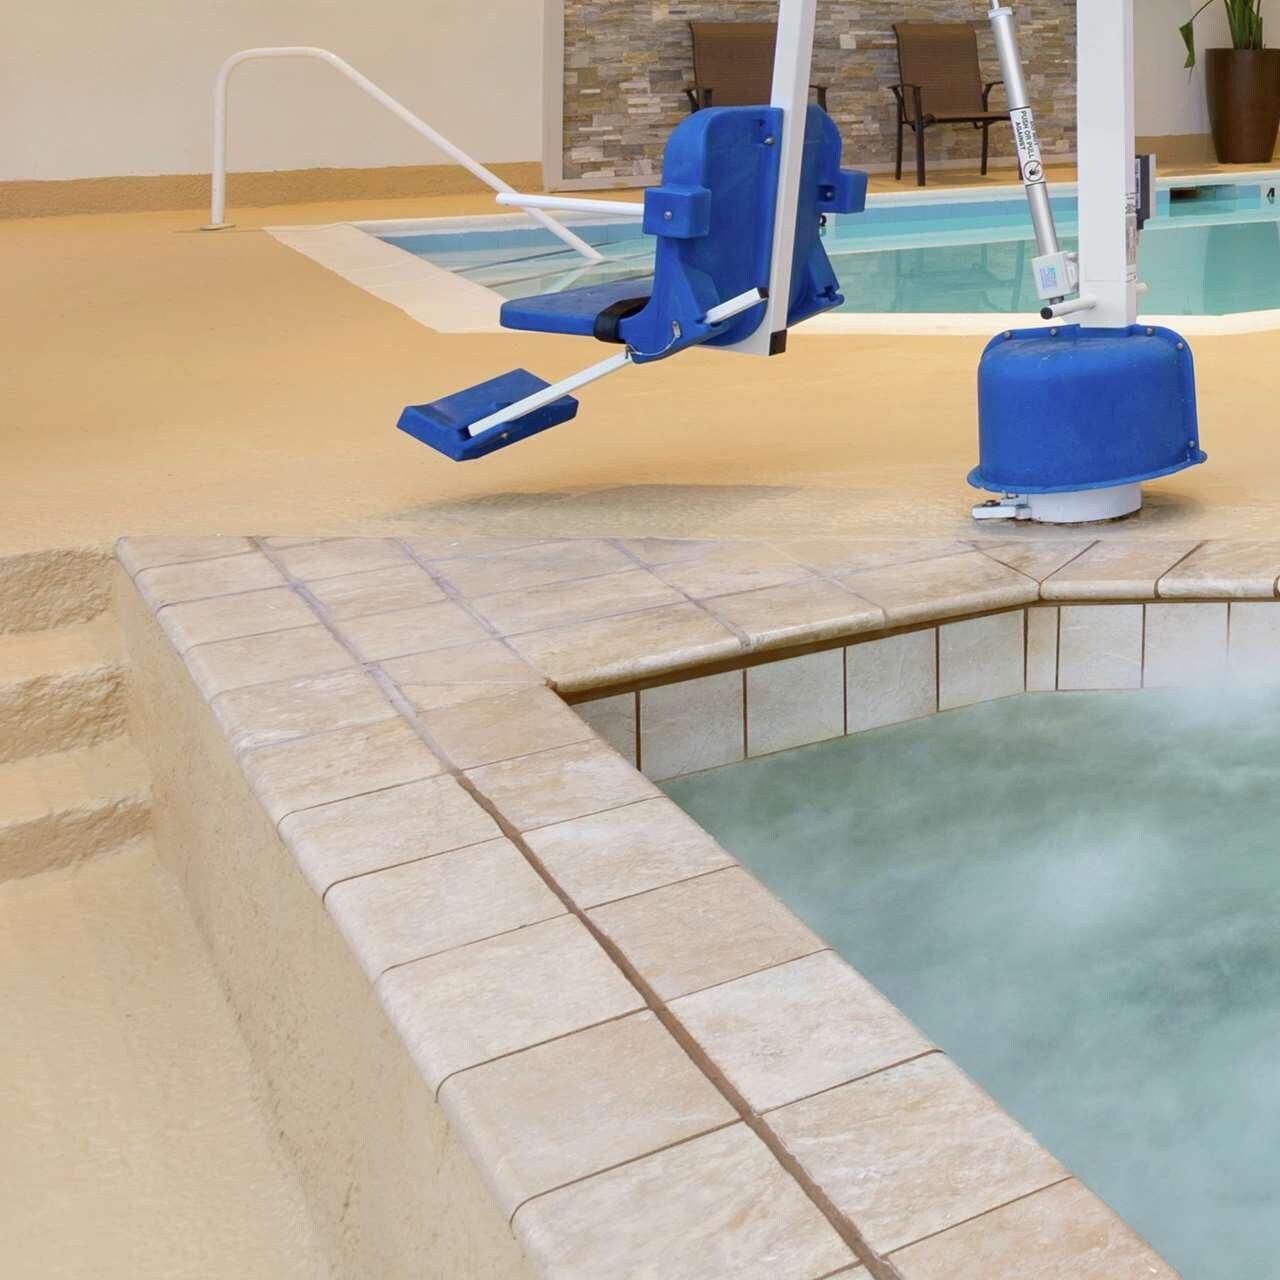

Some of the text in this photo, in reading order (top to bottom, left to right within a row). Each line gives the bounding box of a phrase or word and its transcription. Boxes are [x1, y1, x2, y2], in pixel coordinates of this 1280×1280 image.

[1015, 121, 1026, 150] AGAINST
[1021, 110, 1035, 159] PUSH OR PULL
